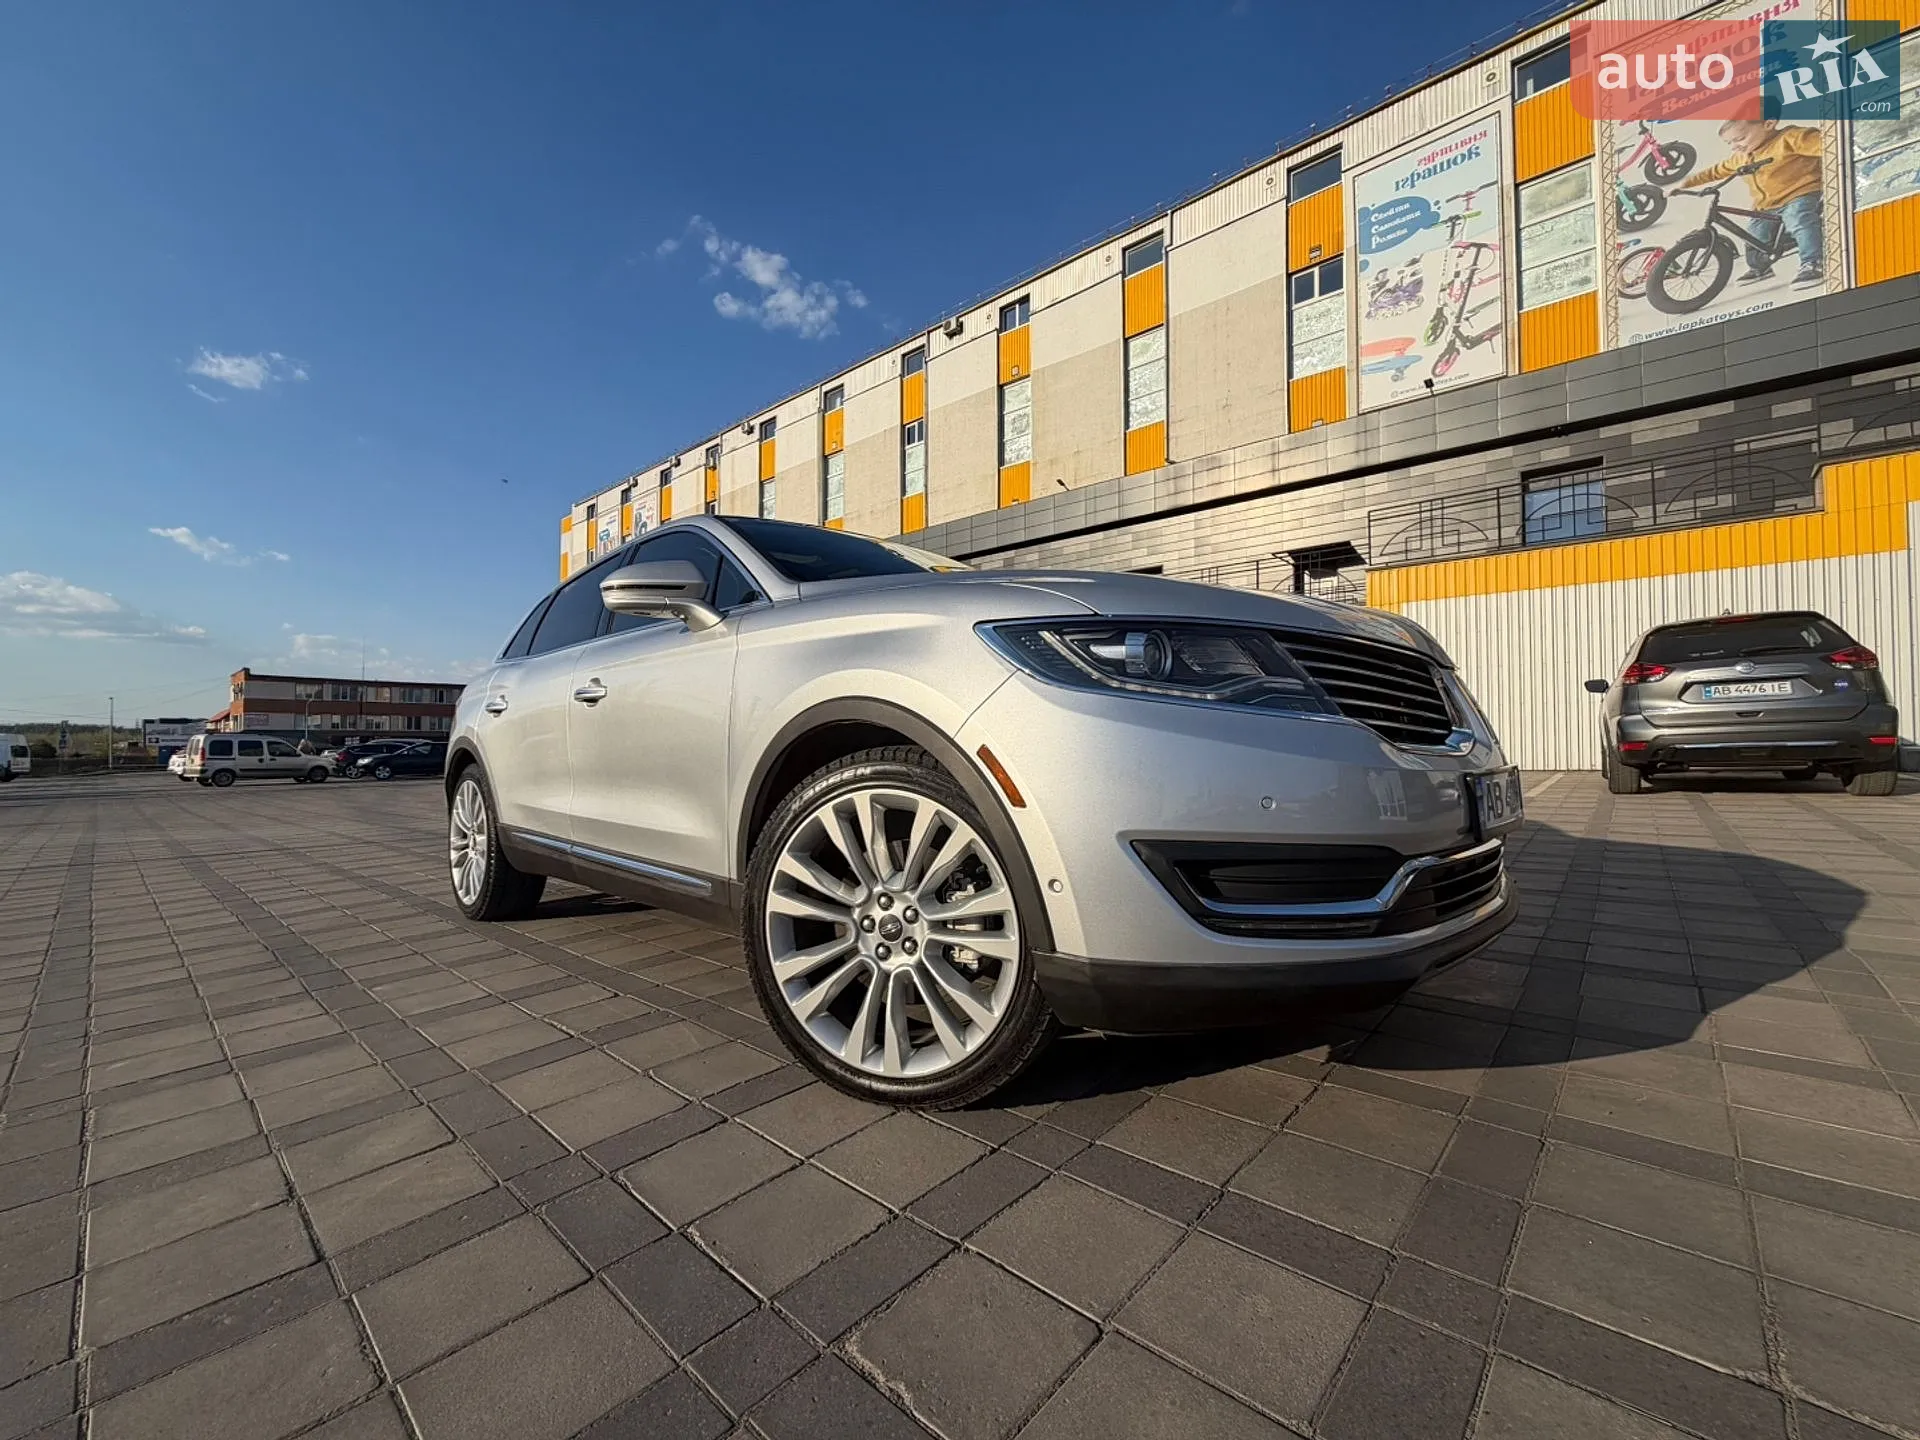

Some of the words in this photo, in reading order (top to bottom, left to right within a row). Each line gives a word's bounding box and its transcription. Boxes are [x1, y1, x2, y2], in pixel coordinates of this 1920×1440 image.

[1644, 301, 1774, 340] www.lapkatoys.com
[1713, 686, 1732, 696] AB
[1734, 684, 1767, 694] 4476
[1771, 682, 1789, 692] IE
